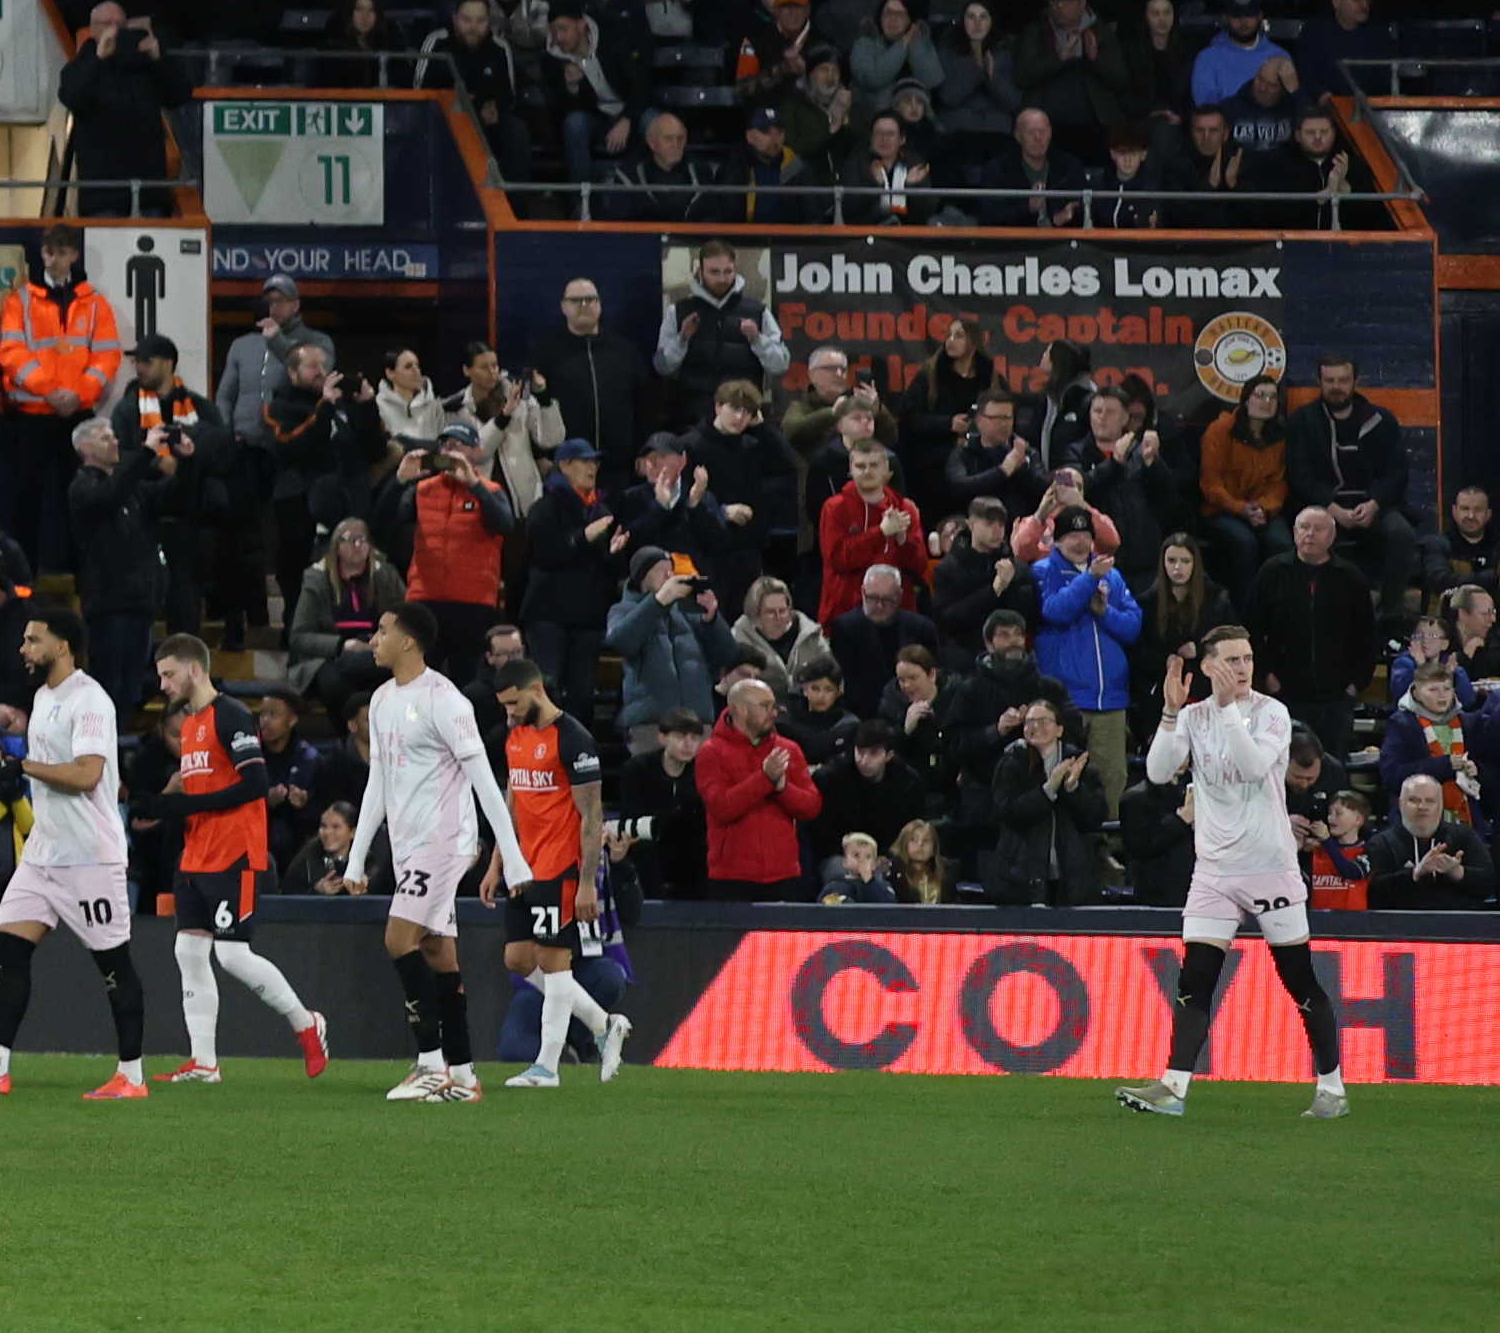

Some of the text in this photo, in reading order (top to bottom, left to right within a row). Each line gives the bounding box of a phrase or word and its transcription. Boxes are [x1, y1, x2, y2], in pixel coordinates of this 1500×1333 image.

[221, 109, 280, 131] EXIT
[317, 156, 350, 206] 11
[264, 248, 330, 272] YOUR
[344, 248, 412, 272] HEAD
[776, 254, 1281, 298] John Charles Lomax
[1004, 305, 1193, 343] Captain
[531, 771, 553, 786] SKY
[396, 870, 430, 897] 23
[1312, 874, 1343, 888] CAPITAL
[79, 898, 112, 926] 10
[214, 900, 233, 928] 6
[530, 906, 559, 935] 21
